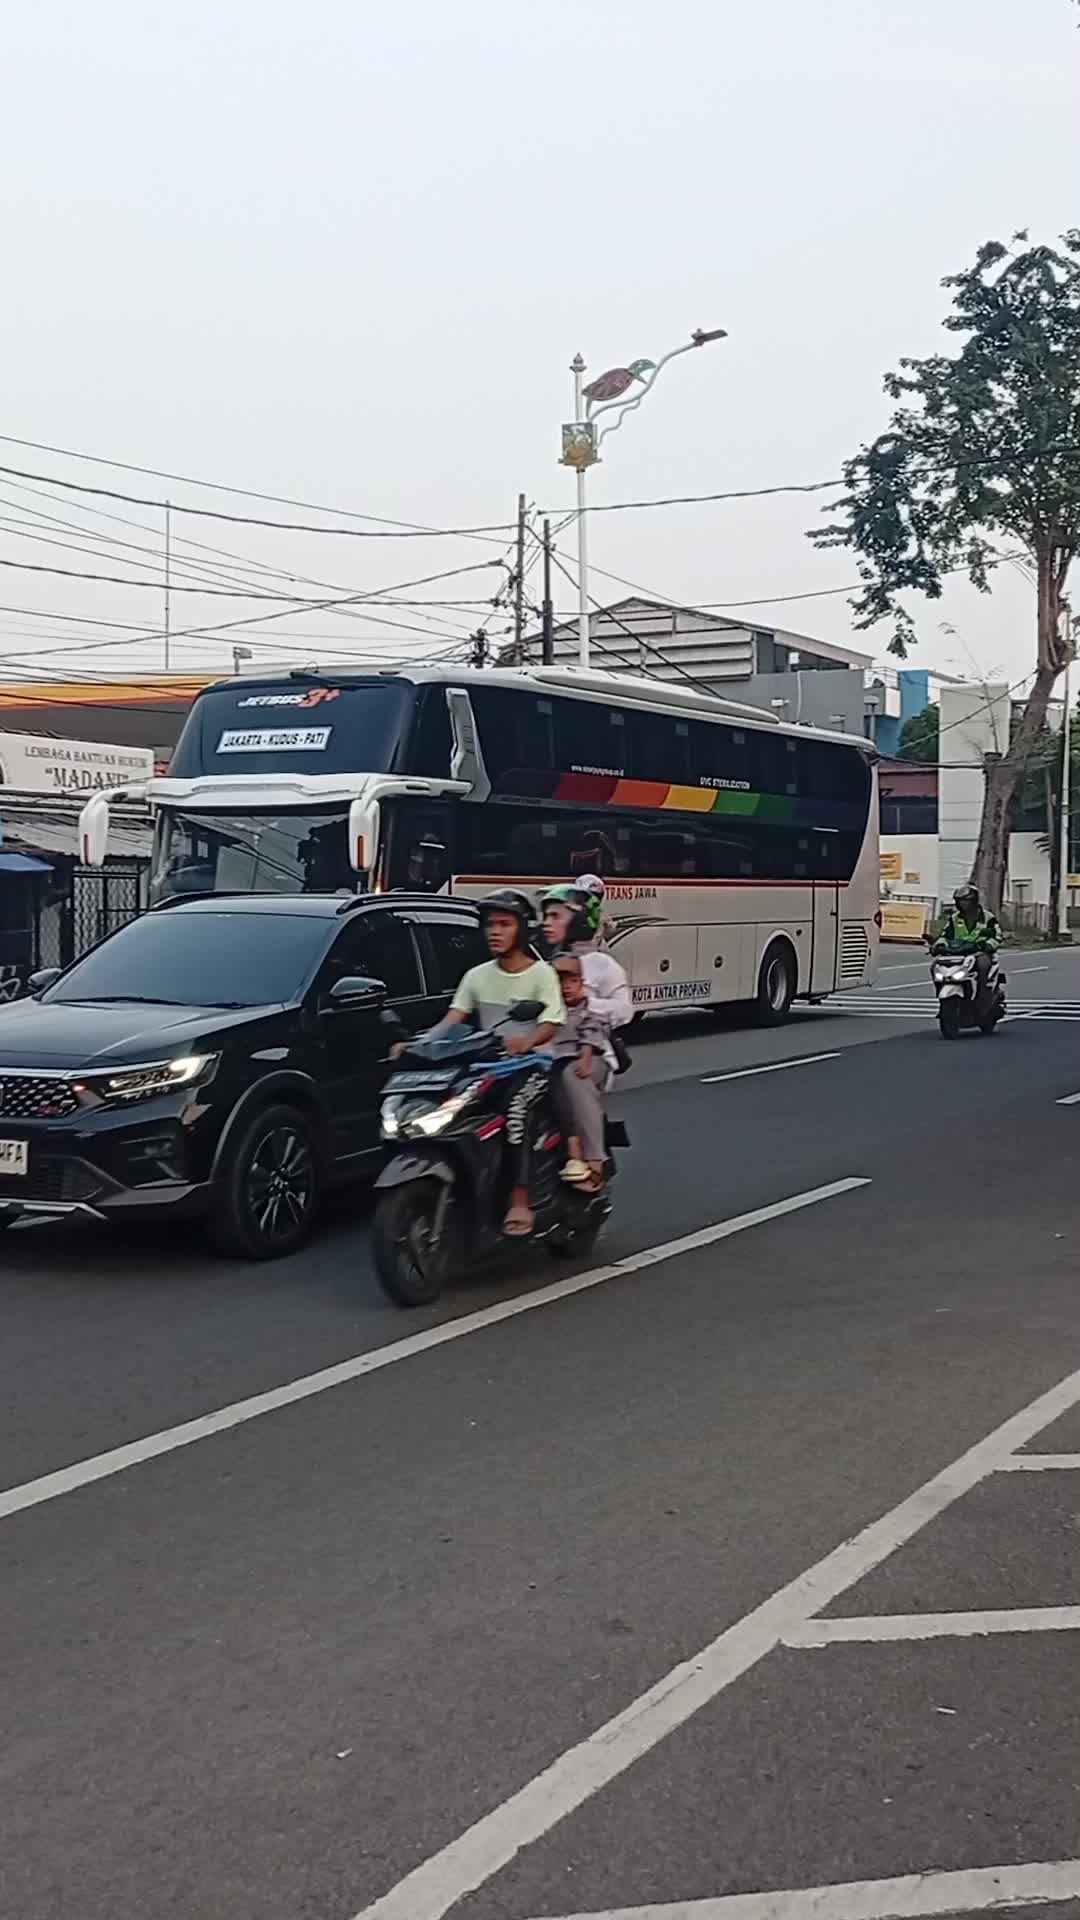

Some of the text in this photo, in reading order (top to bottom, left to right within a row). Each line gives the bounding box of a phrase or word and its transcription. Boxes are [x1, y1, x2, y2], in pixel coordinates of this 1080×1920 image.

[605, 887, 657, 900] TRANS JAWA
[632, 981, 712, 1001] KOTA ANTAR PROPINSI
